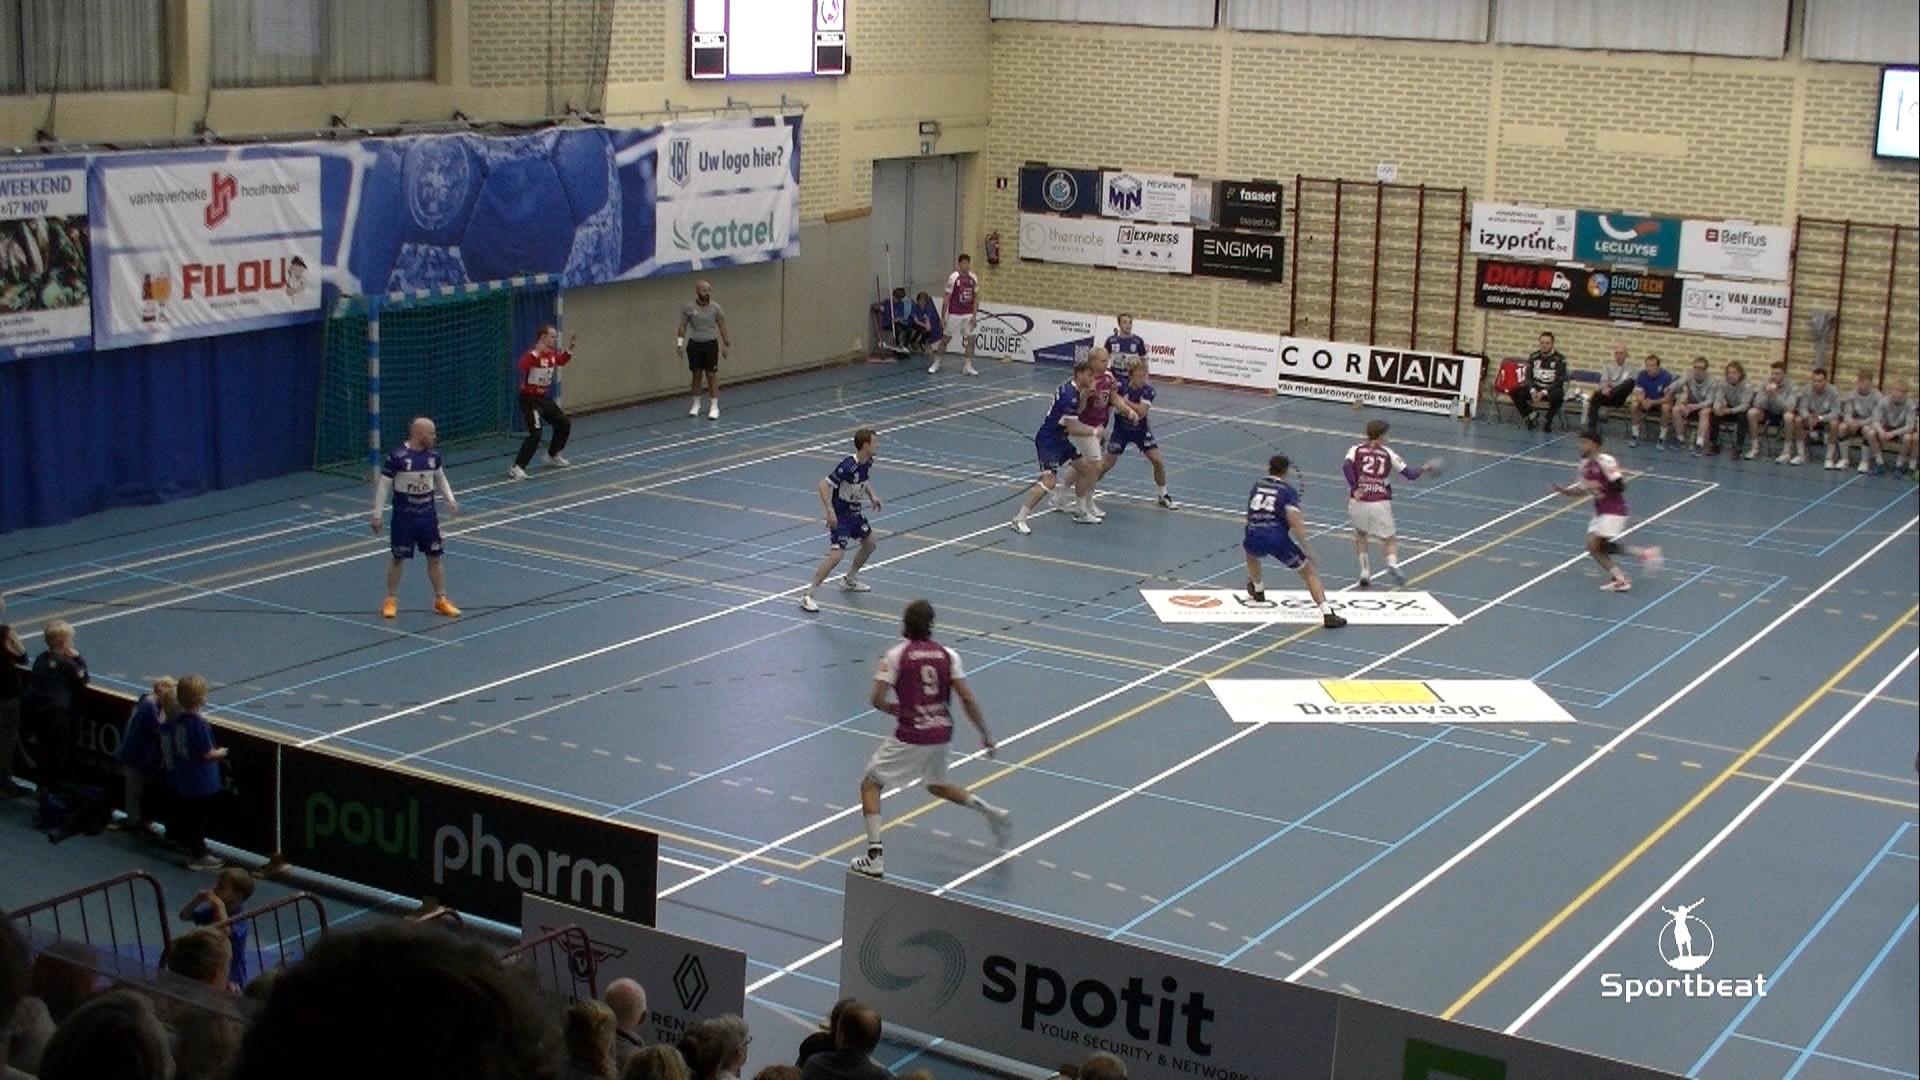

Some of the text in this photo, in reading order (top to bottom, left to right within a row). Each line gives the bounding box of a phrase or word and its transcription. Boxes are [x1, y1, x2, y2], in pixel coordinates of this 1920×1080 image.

[699, 145, 784, 175] Uw logo hier?
[0, 176, 72, 197] WEEKEND
[129, 183, 300, 206] vanhaverbeke houthandel
[1240, 187, 1277, 203] fasset
[23, 200, 49, 214] NOV
[696, 210, 775, 252] catael
[1721, 229, 1767, 247] Belfius
[1203, 239, 1273, 260] ENGIMA
[1594, 241, 1658, 257] LECLUYSE
[182, 257, 287, 300] FILOU
[1728, 292, 1789, 309] VAN AMMEL
[962, 332, 1022, 353] CLUSIEF
[1281, 345, 1459, 386] CORVAN
[1278, 383, 1294, 392] van
[1295, 386, 1377, 402] metaalconstructie
[1378, 394, 1393, 404] tot
[1362, 454, 1386, 475] 27
[920, 665, 940, 696] 9
[1293, 702, 1497, 718] Dessauvage
[305, 791, 625, 914] poul pharm
[982, 954, 1215, 1056] spotit
[1039, 1021, 1080, 1044] YOUR
[1083, 1034, 1154, 1062] SECURITY
[1158, 1055, 1168, 1067] &
